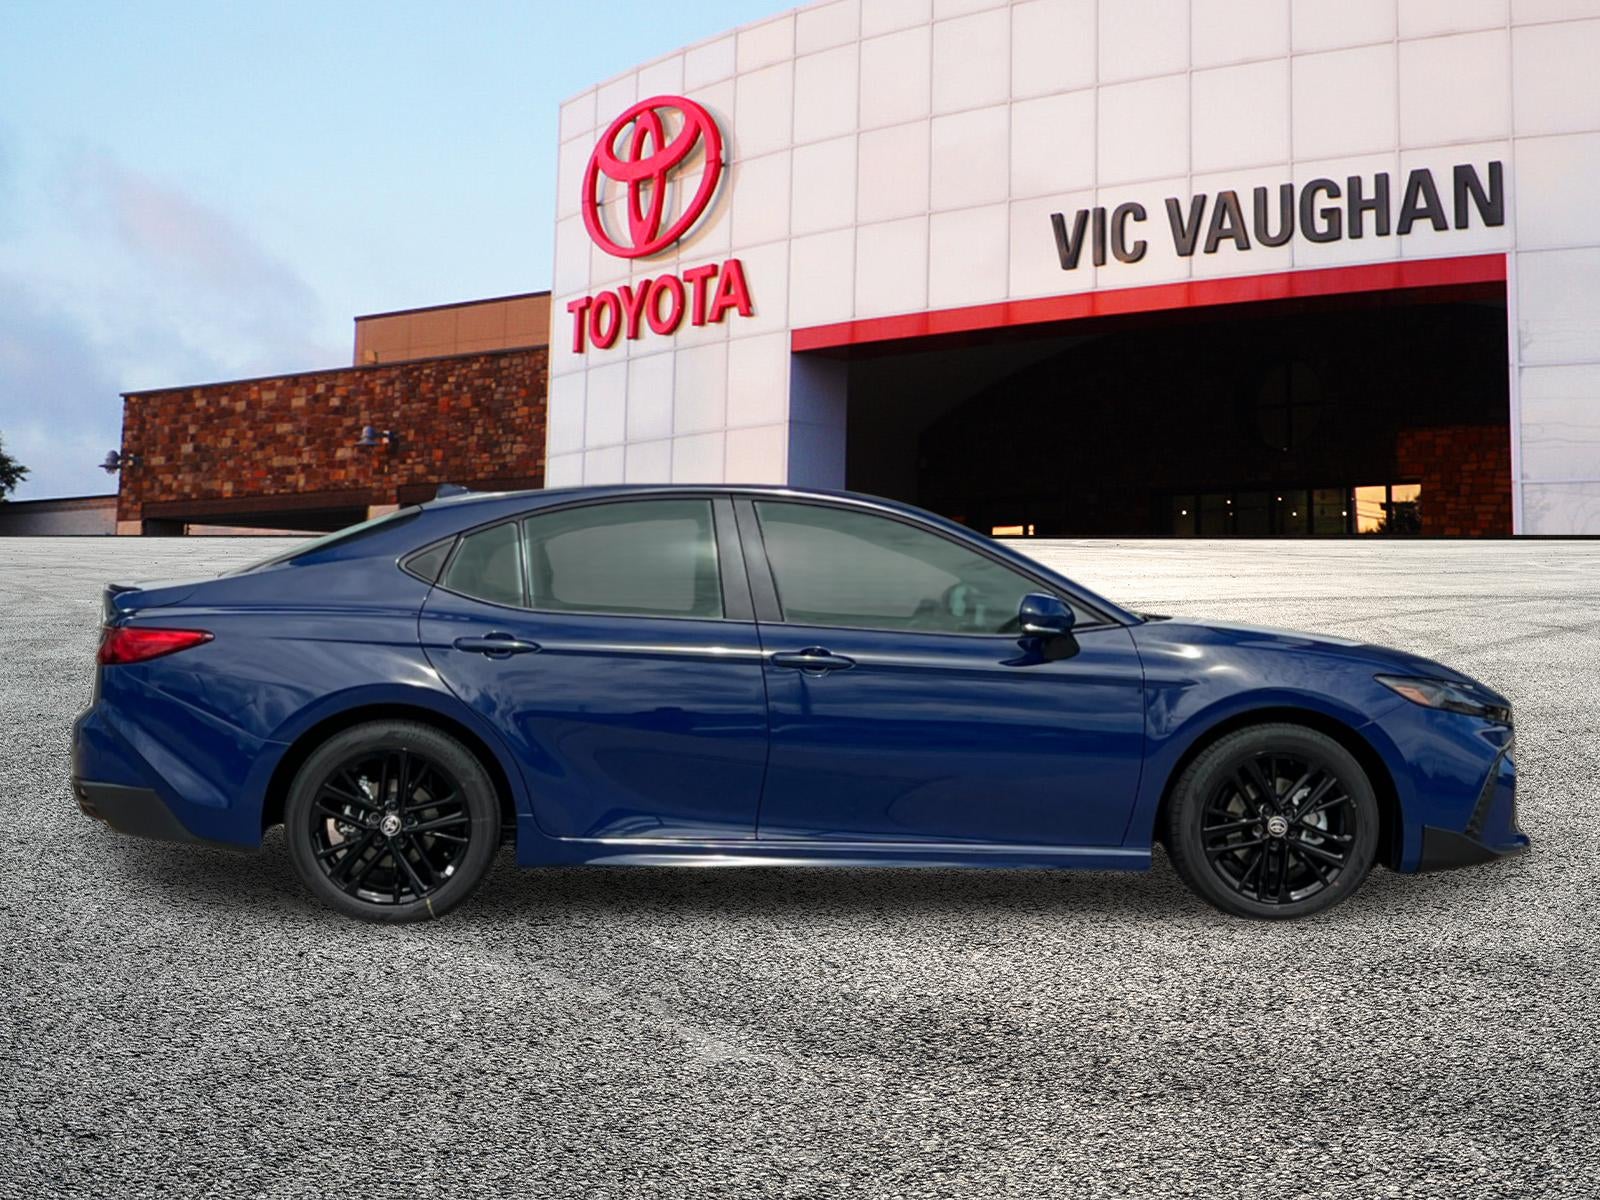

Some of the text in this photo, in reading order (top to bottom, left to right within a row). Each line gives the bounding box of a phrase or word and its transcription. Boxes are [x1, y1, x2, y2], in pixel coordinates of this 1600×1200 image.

[1050, 160, 1505, 271] VIC VAUGHAN
[567, 258, 754, 354] TOYOTA
